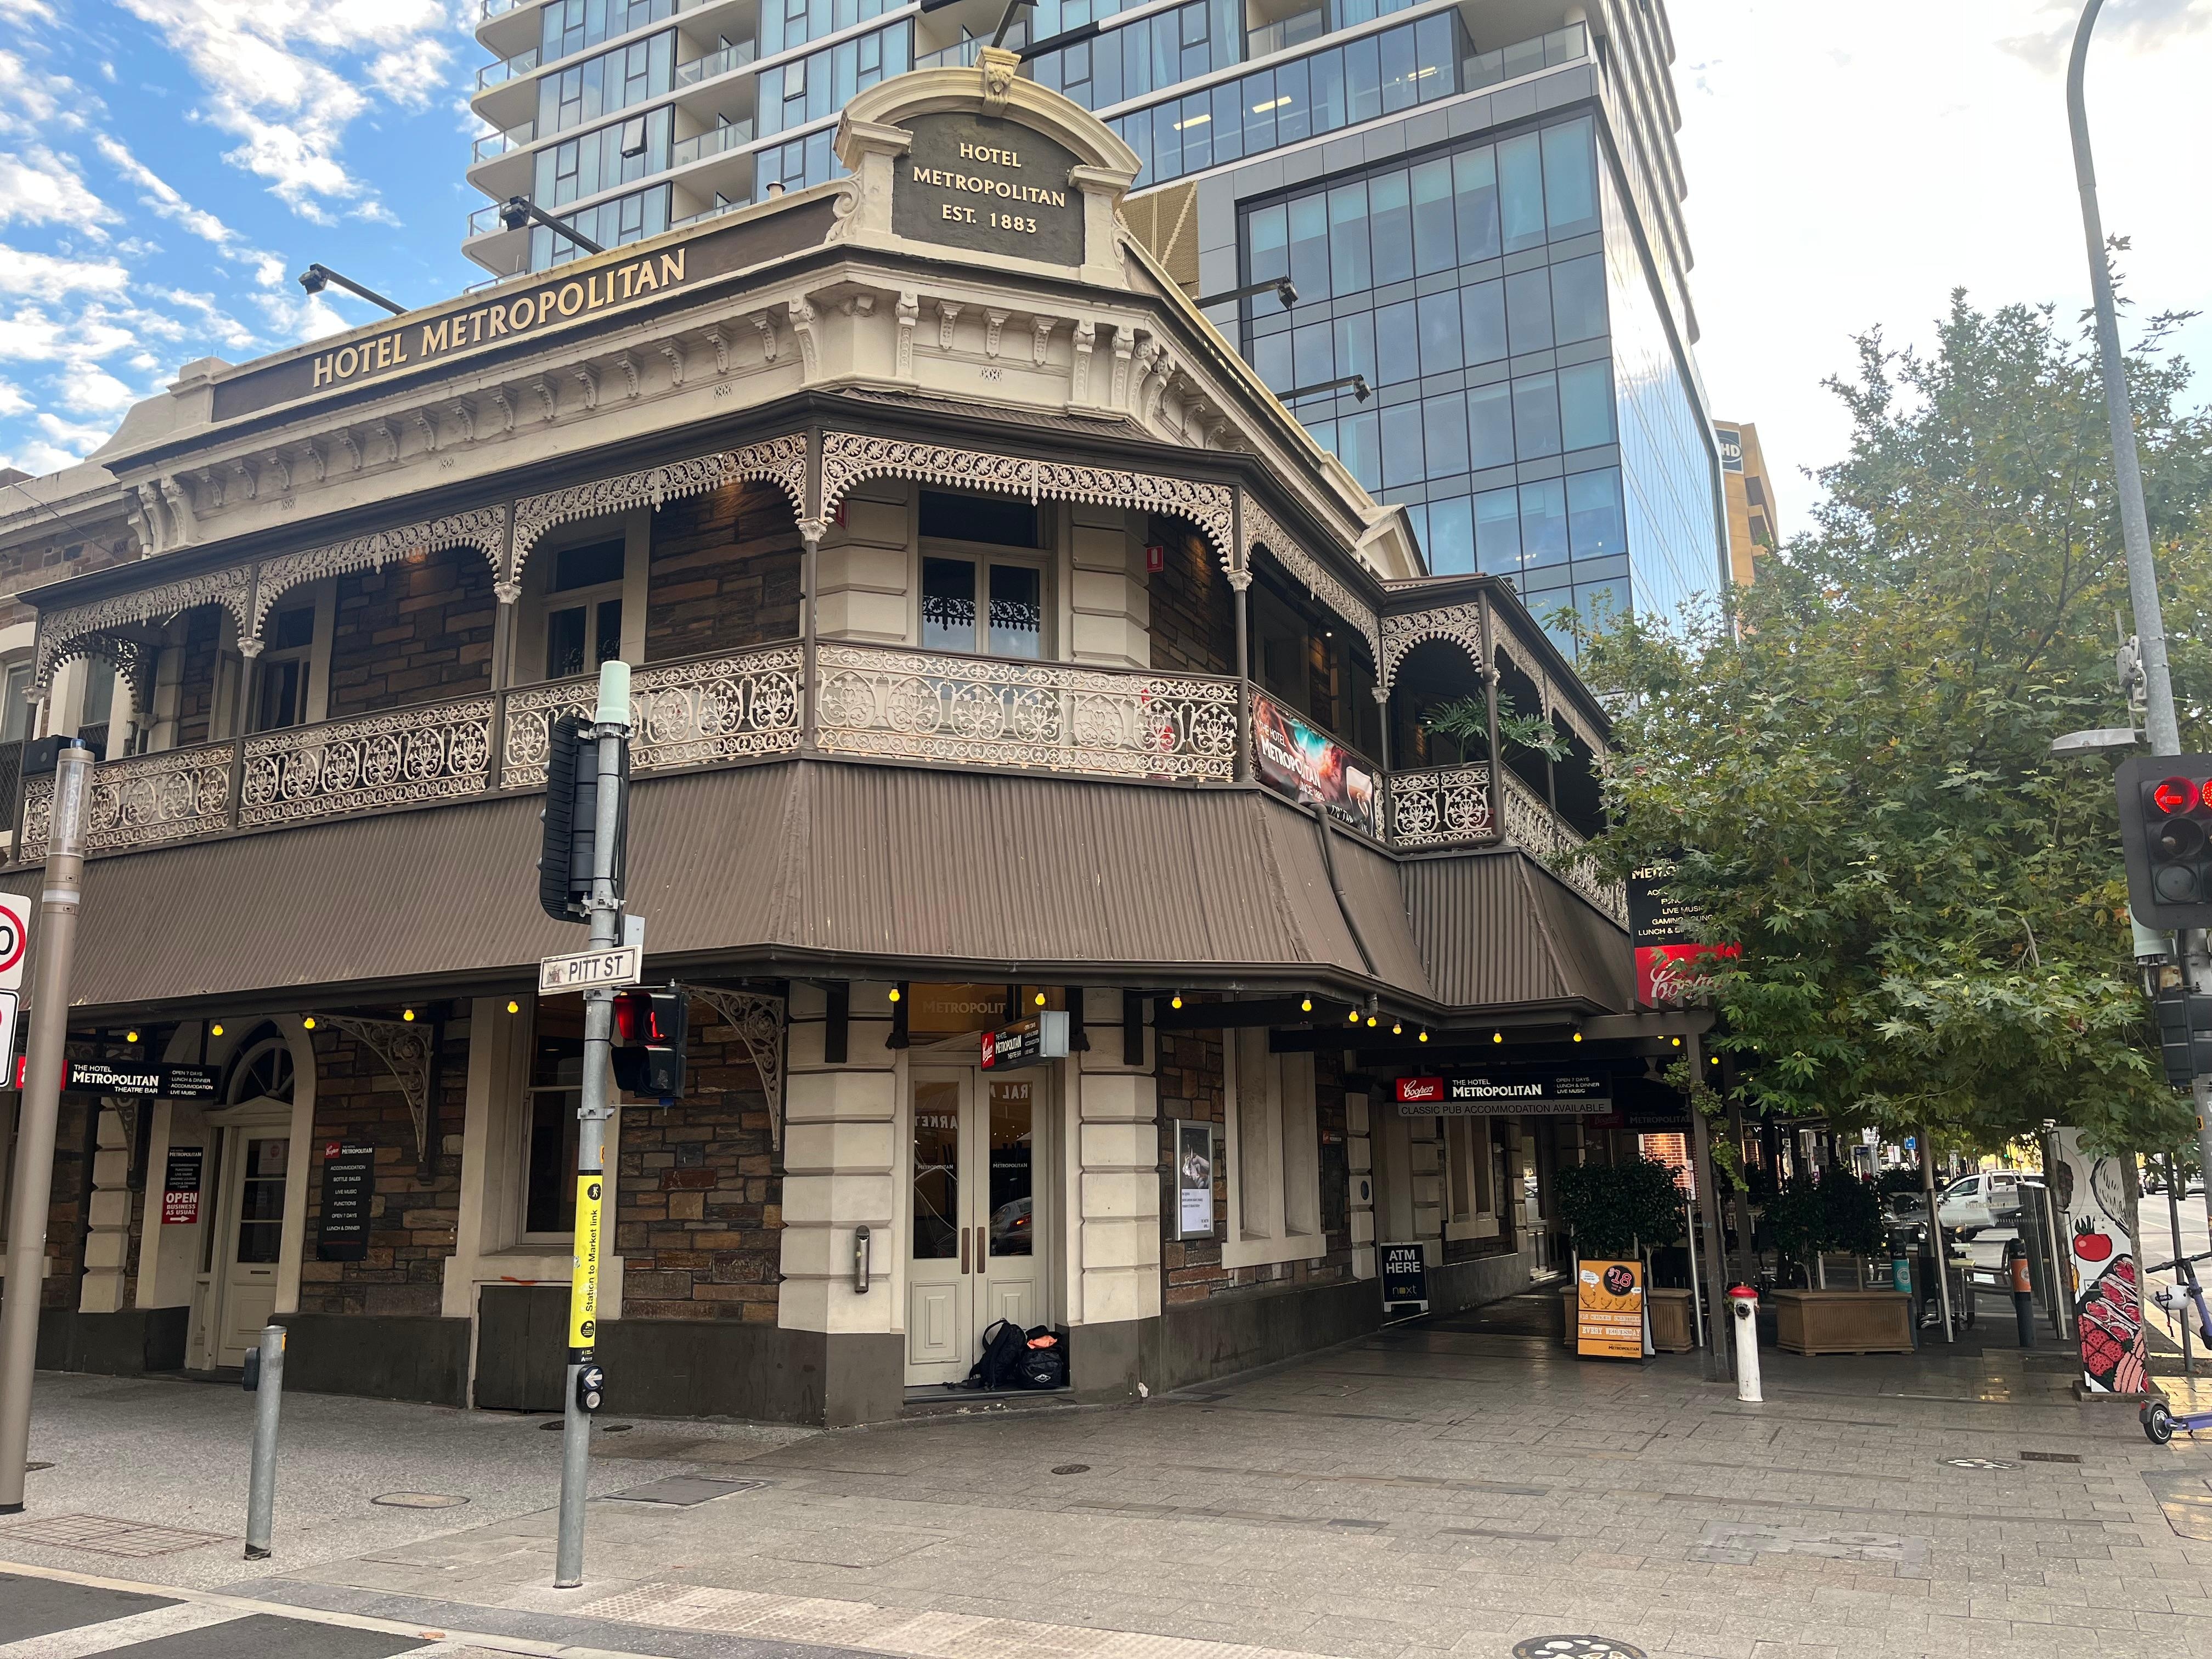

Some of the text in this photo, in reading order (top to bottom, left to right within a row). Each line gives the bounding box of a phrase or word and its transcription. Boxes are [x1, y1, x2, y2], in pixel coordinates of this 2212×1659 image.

[960, 142, 1022, 168] HOTEL
[913, 166, 1065, 207] METROPOLITAN
[942, 204, 1037, 234] EST. 1883
[313, 249, 687, 388] HOTEL METROPOLITAN
[1260, 721, 1286, 747] THE HOTEL
[569, 955, 623, 981] PITT ST
[922, 1001, 1025, 1014] METROPOLIT
[995, 1035, 1022, 1054] METROPOLITAN
[72, 1071, 159, 1087] METROPOLITAN
[1404, 1080, 1434, 1099] Coopers
[1452, 1084, 1542, 1097] METROPOLITAN
[1401, 1107, 1440, 1115] CLASSIC
[1464, 1104, 1550, 1114] ACCOMMODATION
[1553, 1104, 1604, 1113] AVAILABLE
[1629, 1115, 1690, 1124] METROPOLITA
[166, 1192, 198, 1203] OPEN
[588, 1228, 596, 1262] Market
[1389, 1249, 1415, 1261] ATM
[588, 1265, 595, 1275] to
[1386, 1261, 1421, 1274] HERE
[586, 1277, 594, 1312] Station
[1582, 1327, 1640, 1336] EVERY WEDNESDAY
